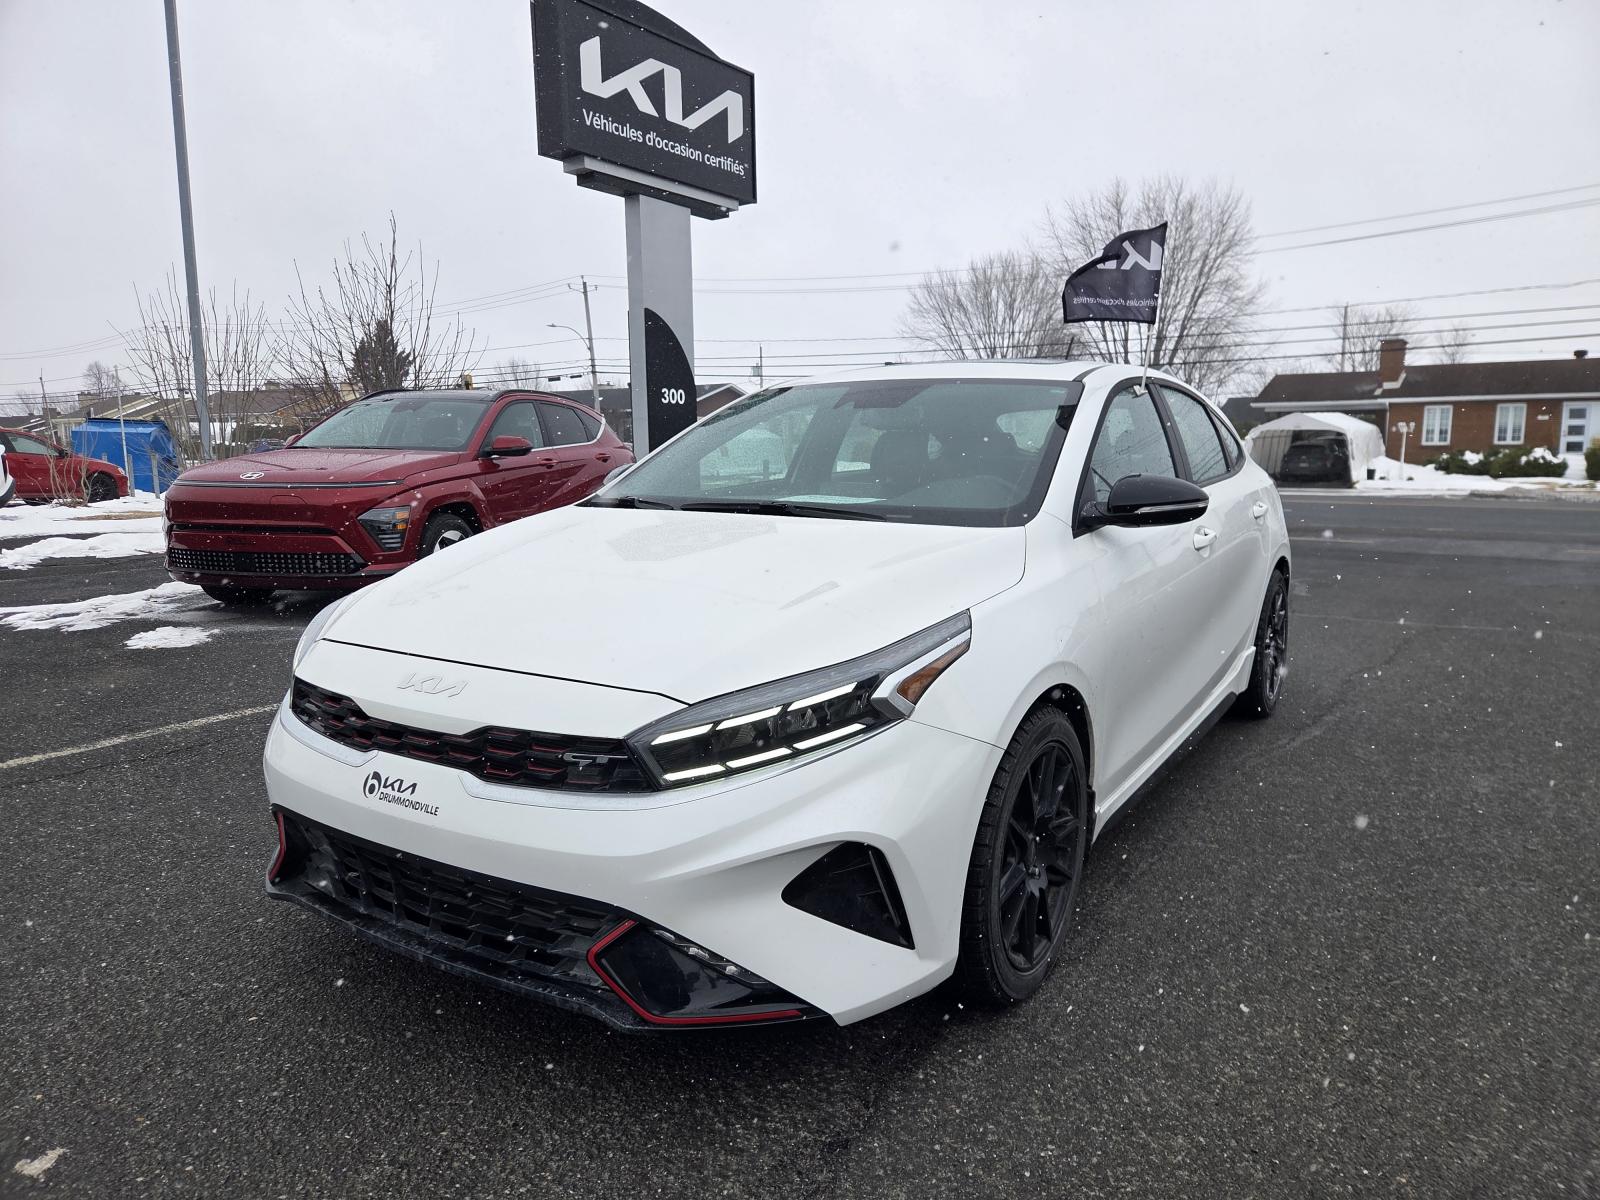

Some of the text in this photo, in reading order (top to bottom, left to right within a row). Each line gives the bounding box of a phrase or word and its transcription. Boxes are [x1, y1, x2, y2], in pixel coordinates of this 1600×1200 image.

[580, 35, 743, 144] KIA
[582, 108, 744, 176] Véhicules d'occasion certifiés
[661, 388, 685, 404] 300
[382, 776, 418, 796] KIA
[378, 791, 440, 816] DRUMMONDVILLE
